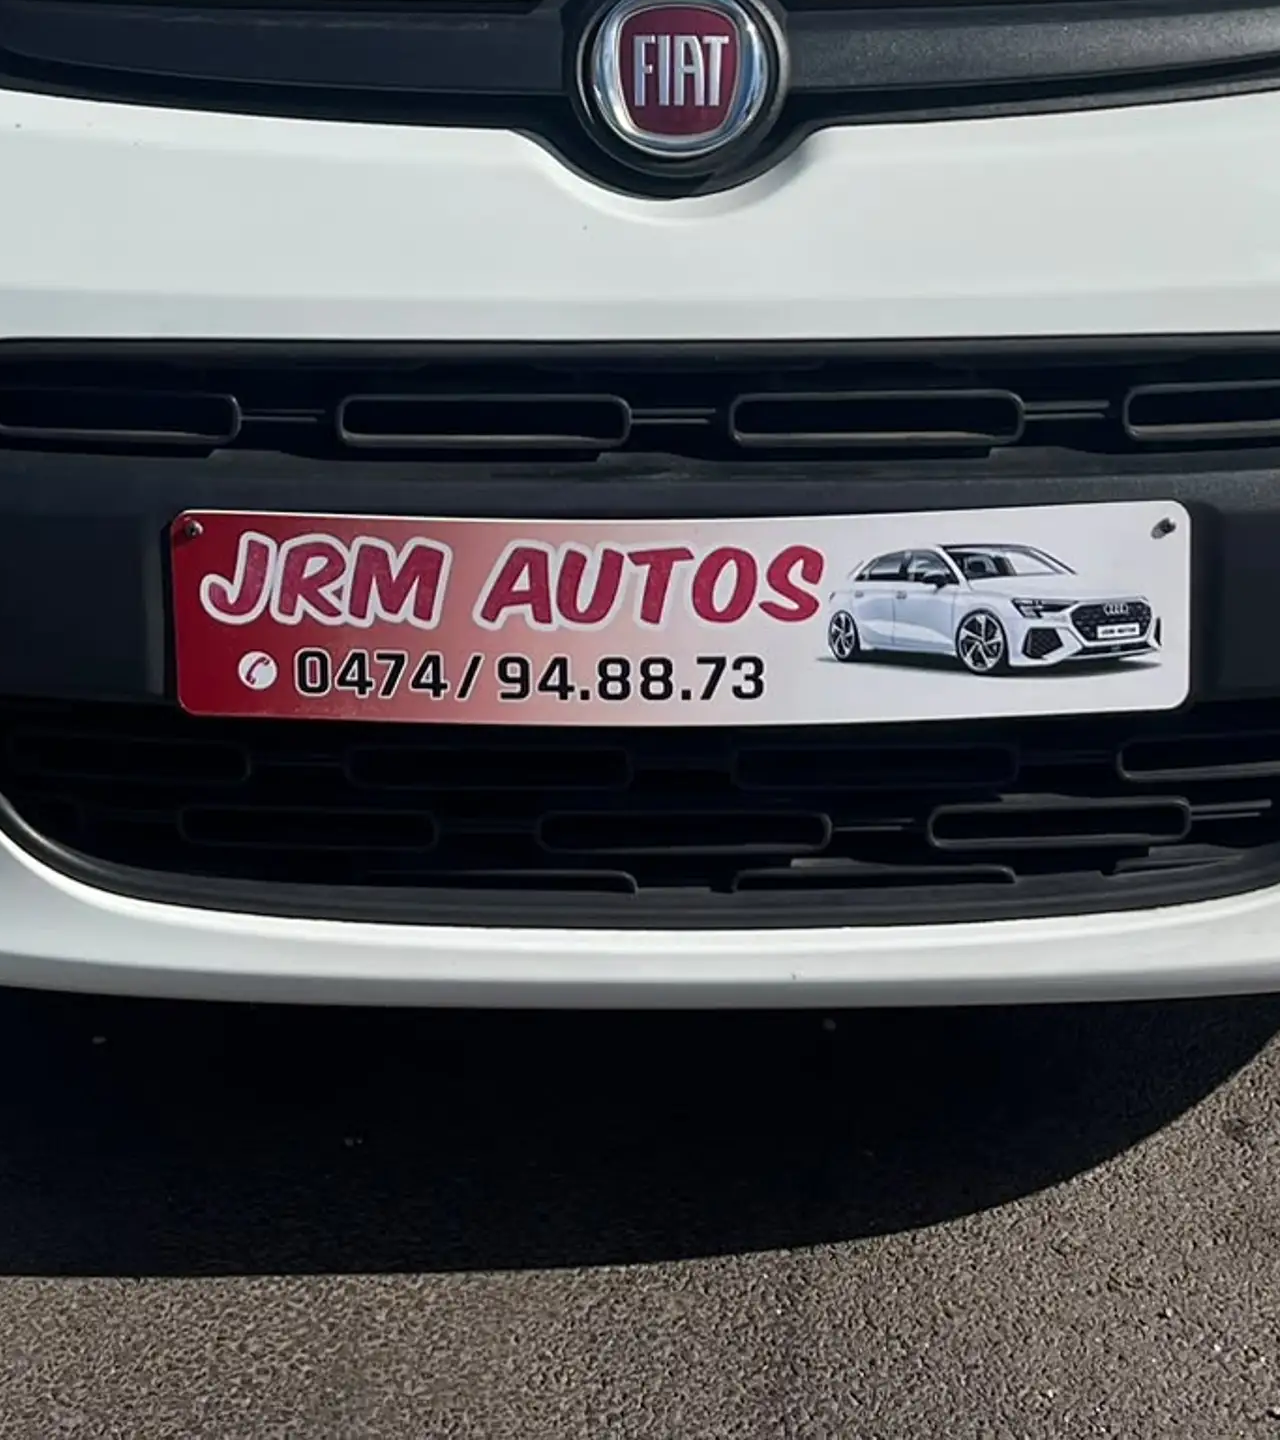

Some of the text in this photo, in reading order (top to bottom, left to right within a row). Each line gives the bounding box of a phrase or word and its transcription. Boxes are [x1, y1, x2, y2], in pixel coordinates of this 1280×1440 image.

[631, 34, 730, 107] FIAT
[201, 532, 825, 630] JRM AUTOS
